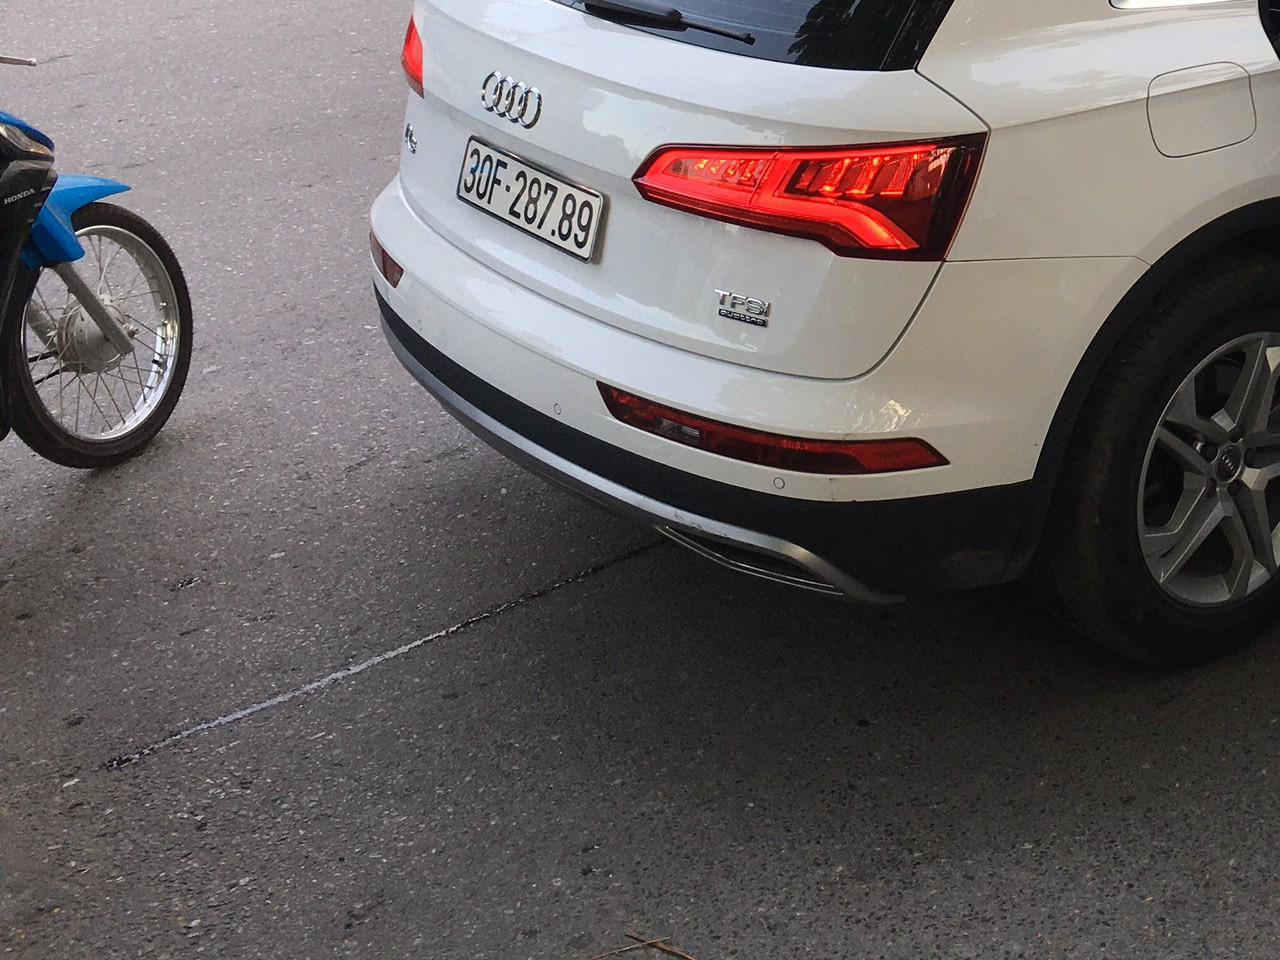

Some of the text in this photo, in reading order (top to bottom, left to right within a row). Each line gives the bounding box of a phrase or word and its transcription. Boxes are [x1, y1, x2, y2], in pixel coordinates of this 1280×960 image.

[3, 188, 36, 205] HONDA
[463, 146, 595, 250] 30F-287.89
[714, 288, 772, 318] TFSI
